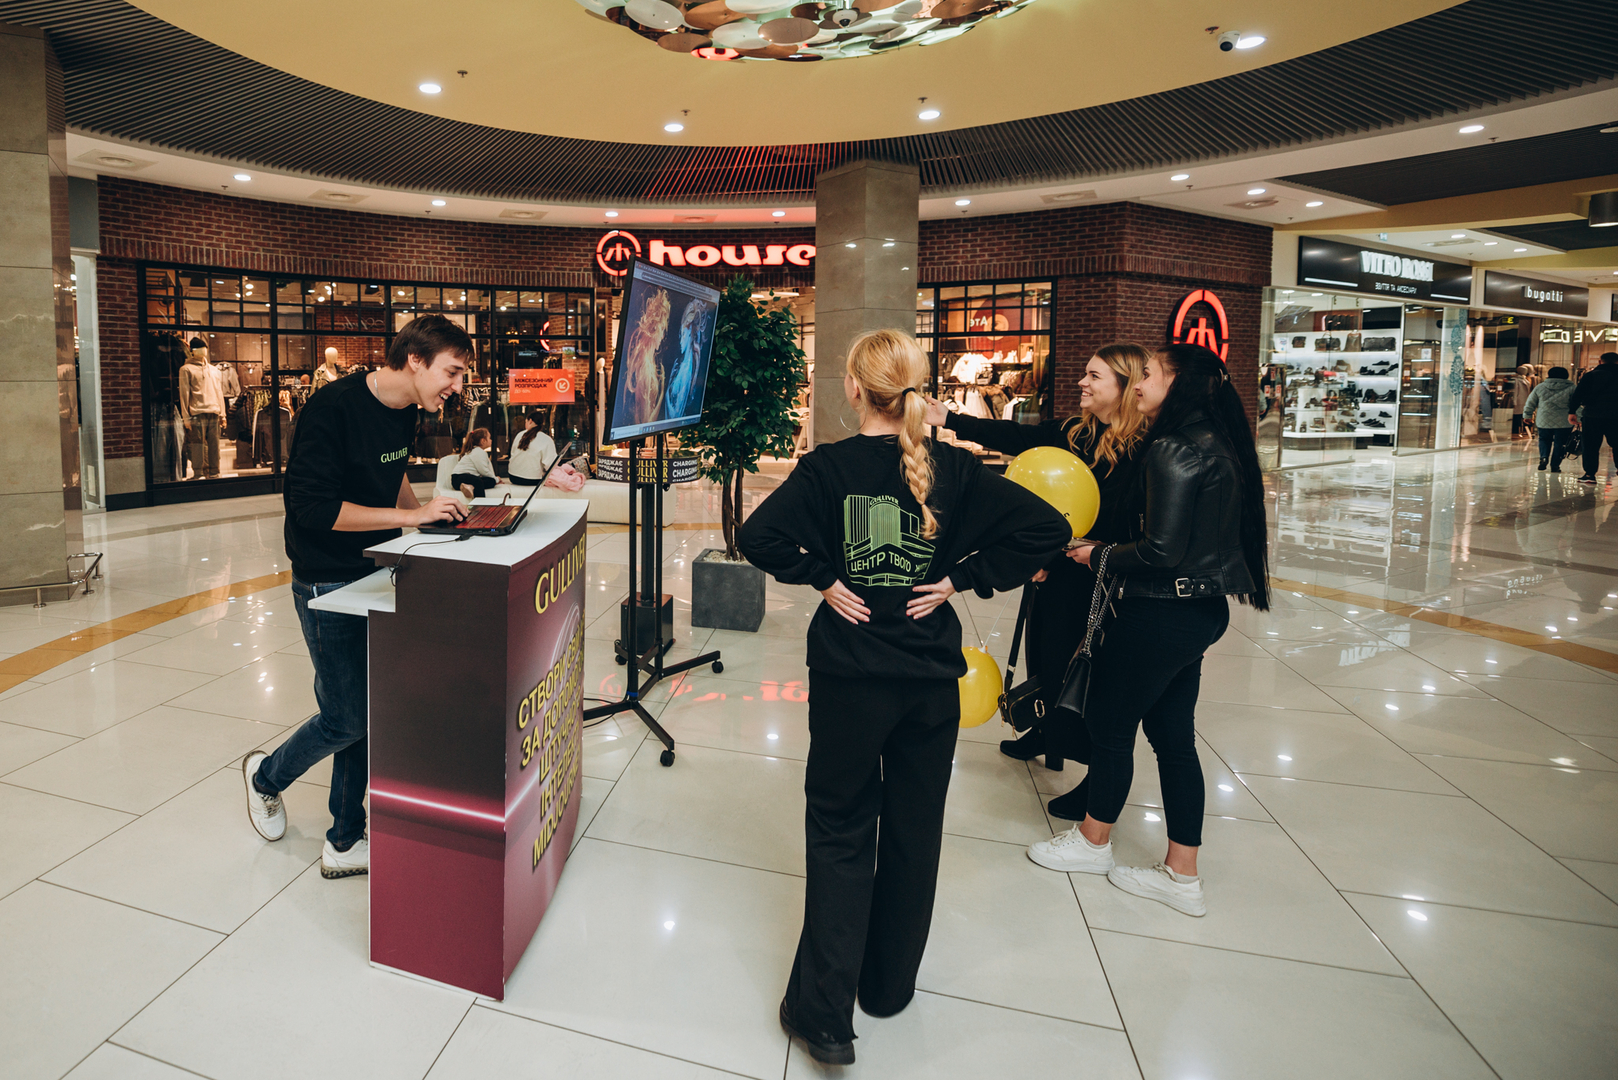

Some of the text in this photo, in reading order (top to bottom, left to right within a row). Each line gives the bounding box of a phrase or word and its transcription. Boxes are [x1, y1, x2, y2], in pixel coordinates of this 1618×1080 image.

[650, 239, 816, 266] house
[1360, 250, 1434, 282] VITTO ROSSI
[1526, 286, 1563, 303] bugatti
[851, 552, 886, 573] ЦЕНТР
[518, 653, 566, 729] СТВОРИ
[521, 726, 541, 767] ЗА
